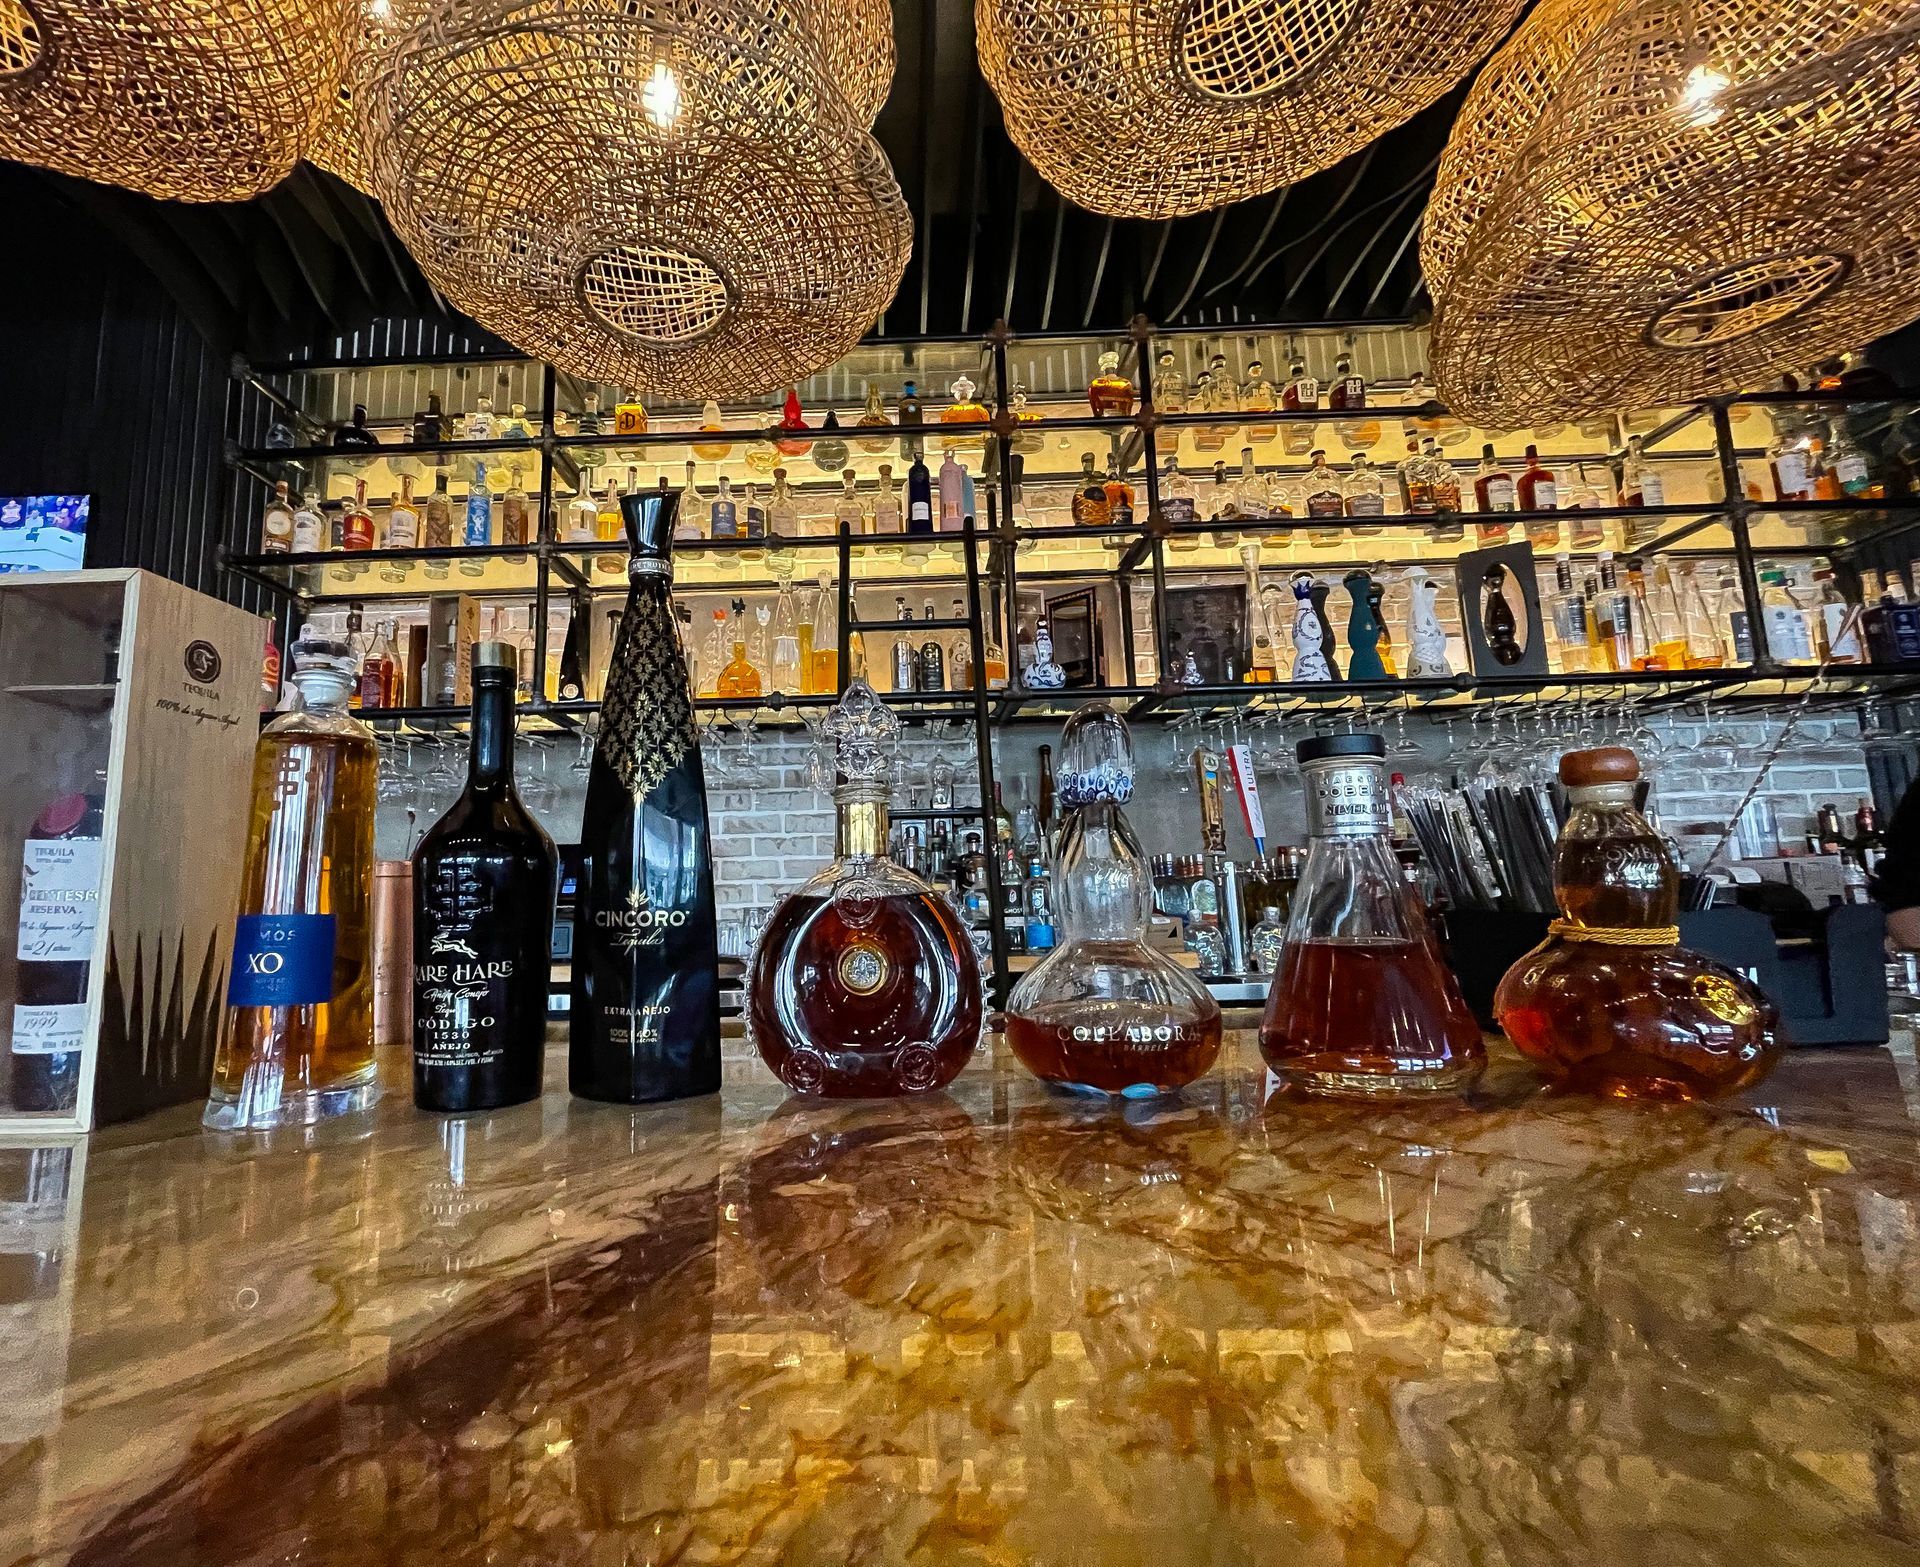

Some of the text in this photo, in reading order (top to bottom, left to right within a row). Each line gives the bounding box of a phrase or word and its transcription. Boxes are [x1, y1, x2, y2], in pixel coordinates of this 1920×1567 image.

[182, 682, 220, 701] TEQUILA
[1242, 750, 1255, 784] ULTRA
[595, 910, 686, 927] CINCORO
[609, 928, 665, 956] Tequila
[245, 952, 285, 974] XO
[452, 961, 514, 986] HARE
[604, 1005, 671, 1016] EXTRA AÑEJO
[434, 1031, 470, 1040] 1530
[432, 1041, 471, 1050] AÑEJO
